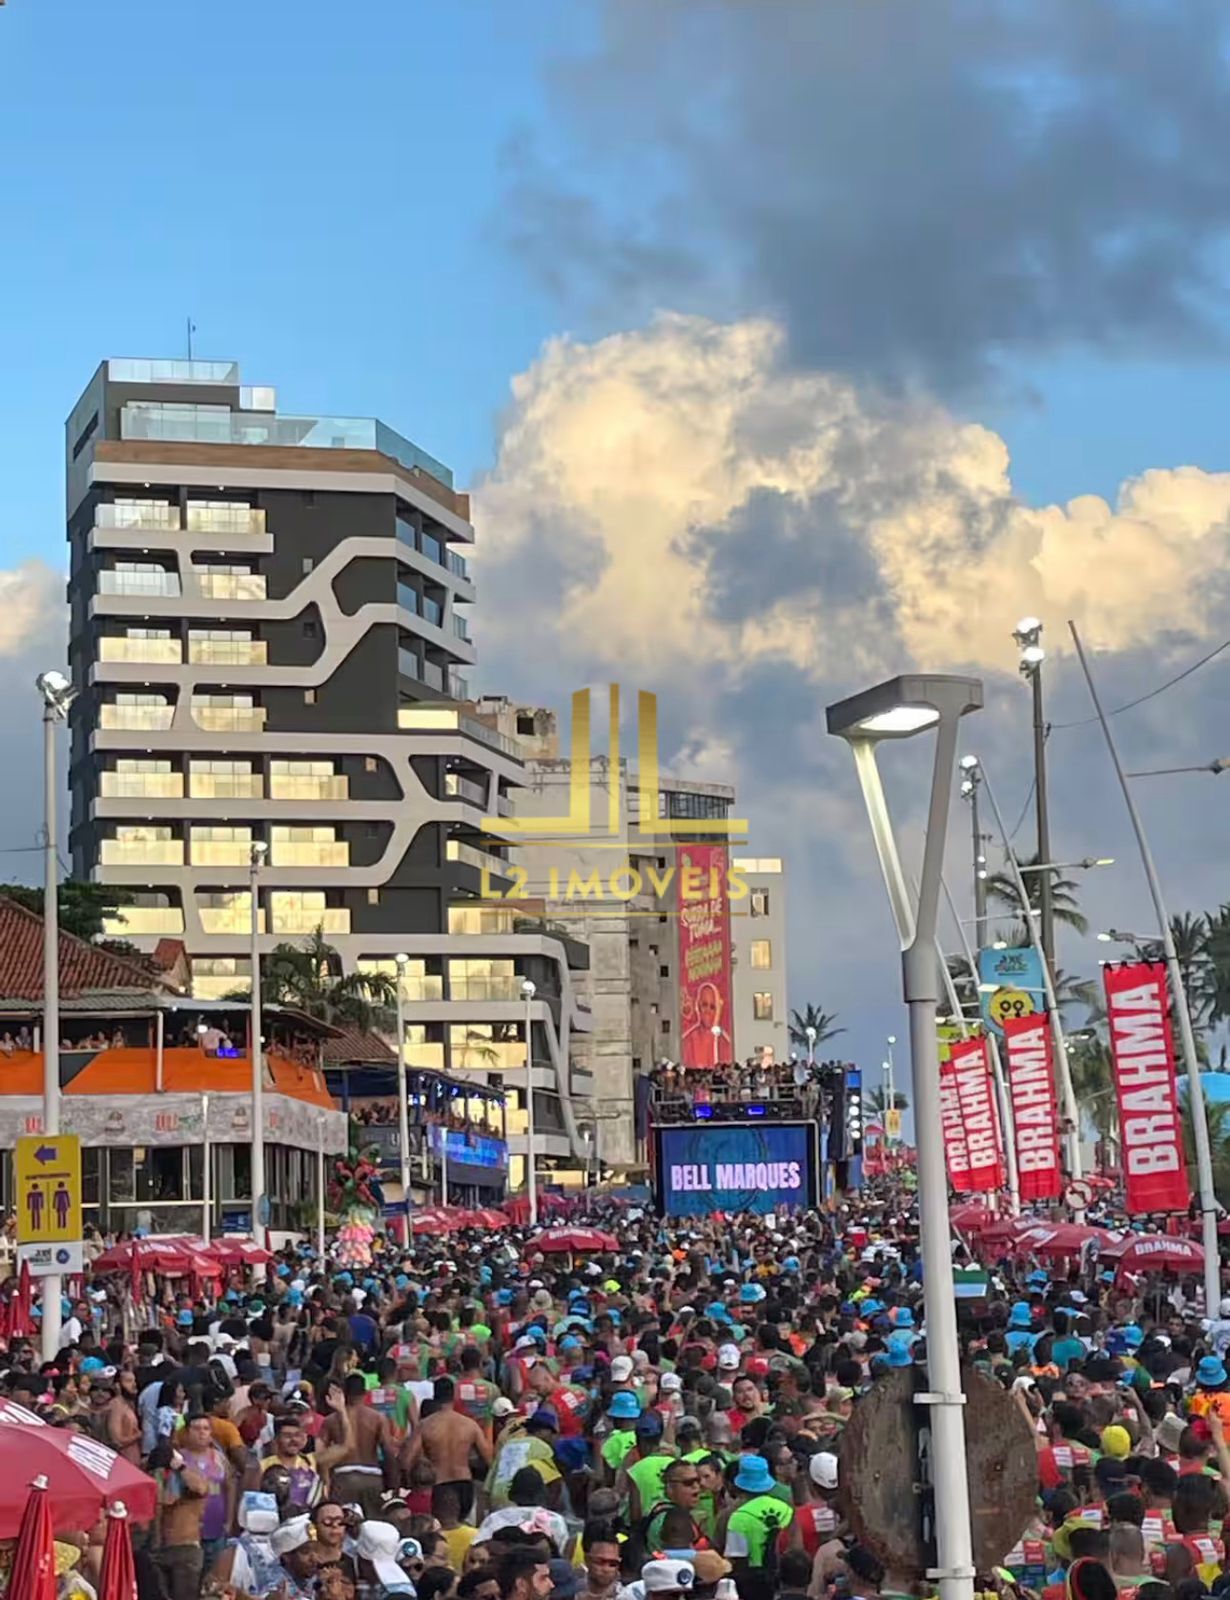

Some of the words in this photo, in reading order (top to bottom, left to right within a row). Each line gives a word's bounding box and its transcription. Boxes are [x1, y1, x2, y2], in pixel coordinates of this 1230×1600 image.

[953, 1049, 997, 1169] BRAHMA
[1007, 1027, 1055, 1172] BRAHMA
[1111, 982, 1179, 1175] BRAHMA
[671, 1164, 712, 1191] BELL
[715, 1162, 800, 1191] MARQUES
[1134, 1240, 1193, 1257] BRAHMA
